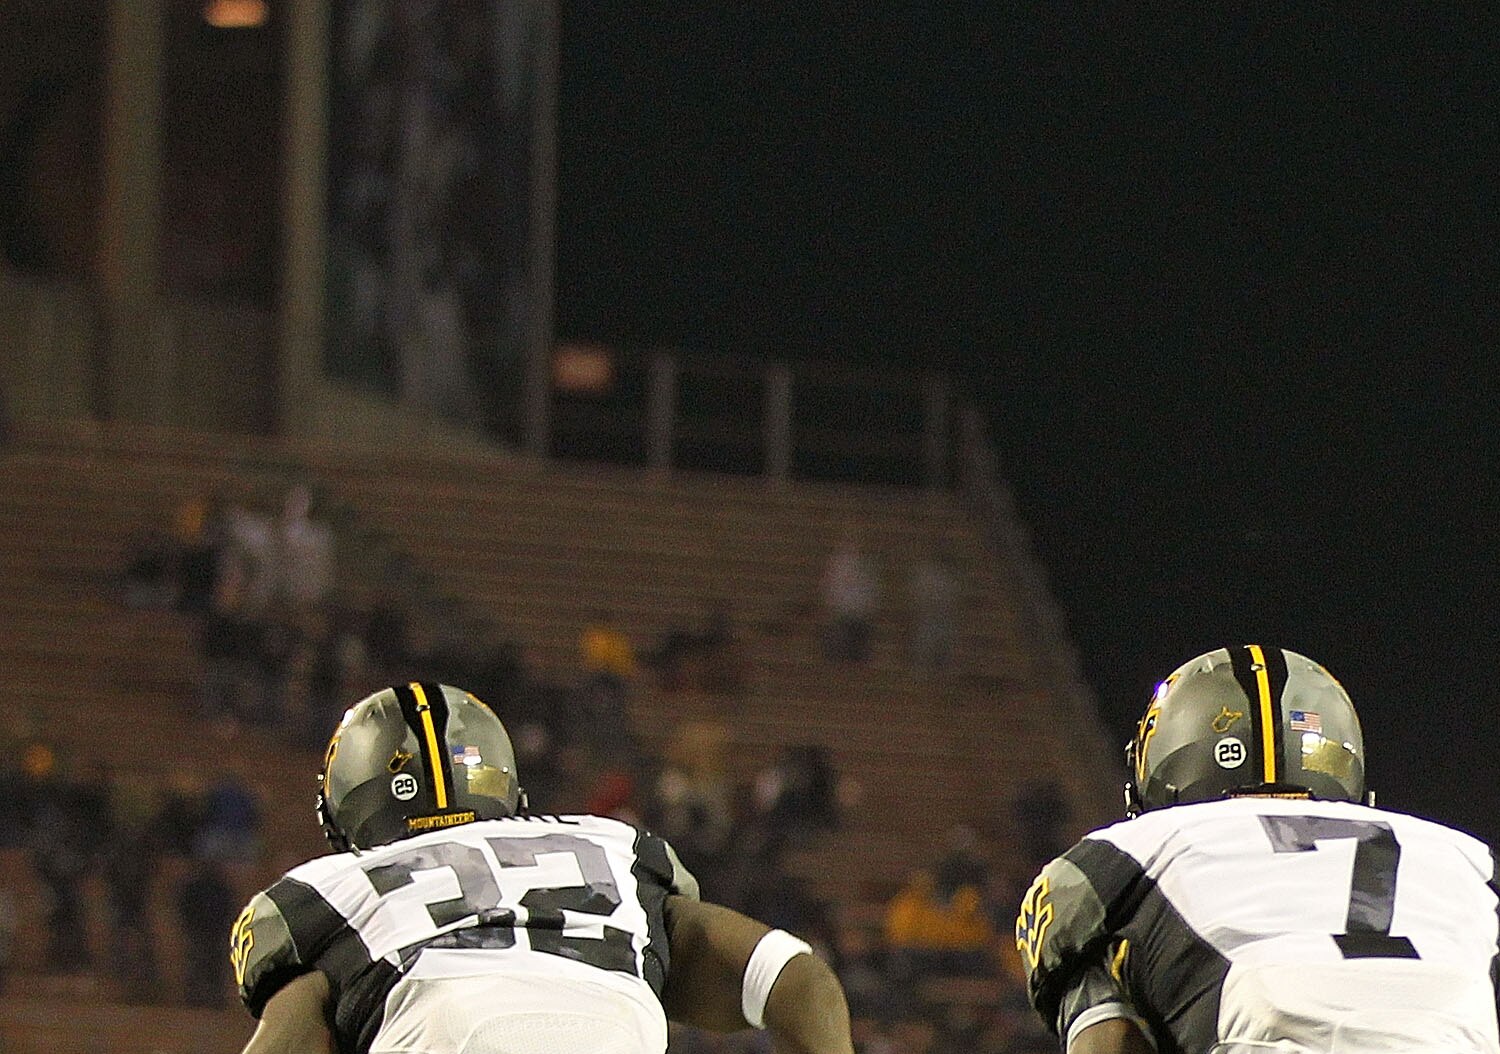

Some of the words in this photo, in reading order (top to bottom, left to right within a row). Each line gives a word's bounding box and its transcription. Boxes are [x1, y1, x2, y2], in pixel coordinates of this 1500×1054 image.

[1218, 743, 1241, 762] 29
[394, 778, 415, 795] 29
[407, 811, 475, 830] MOUNTAINEERS
[1257, 814, 1422, 960] 7
